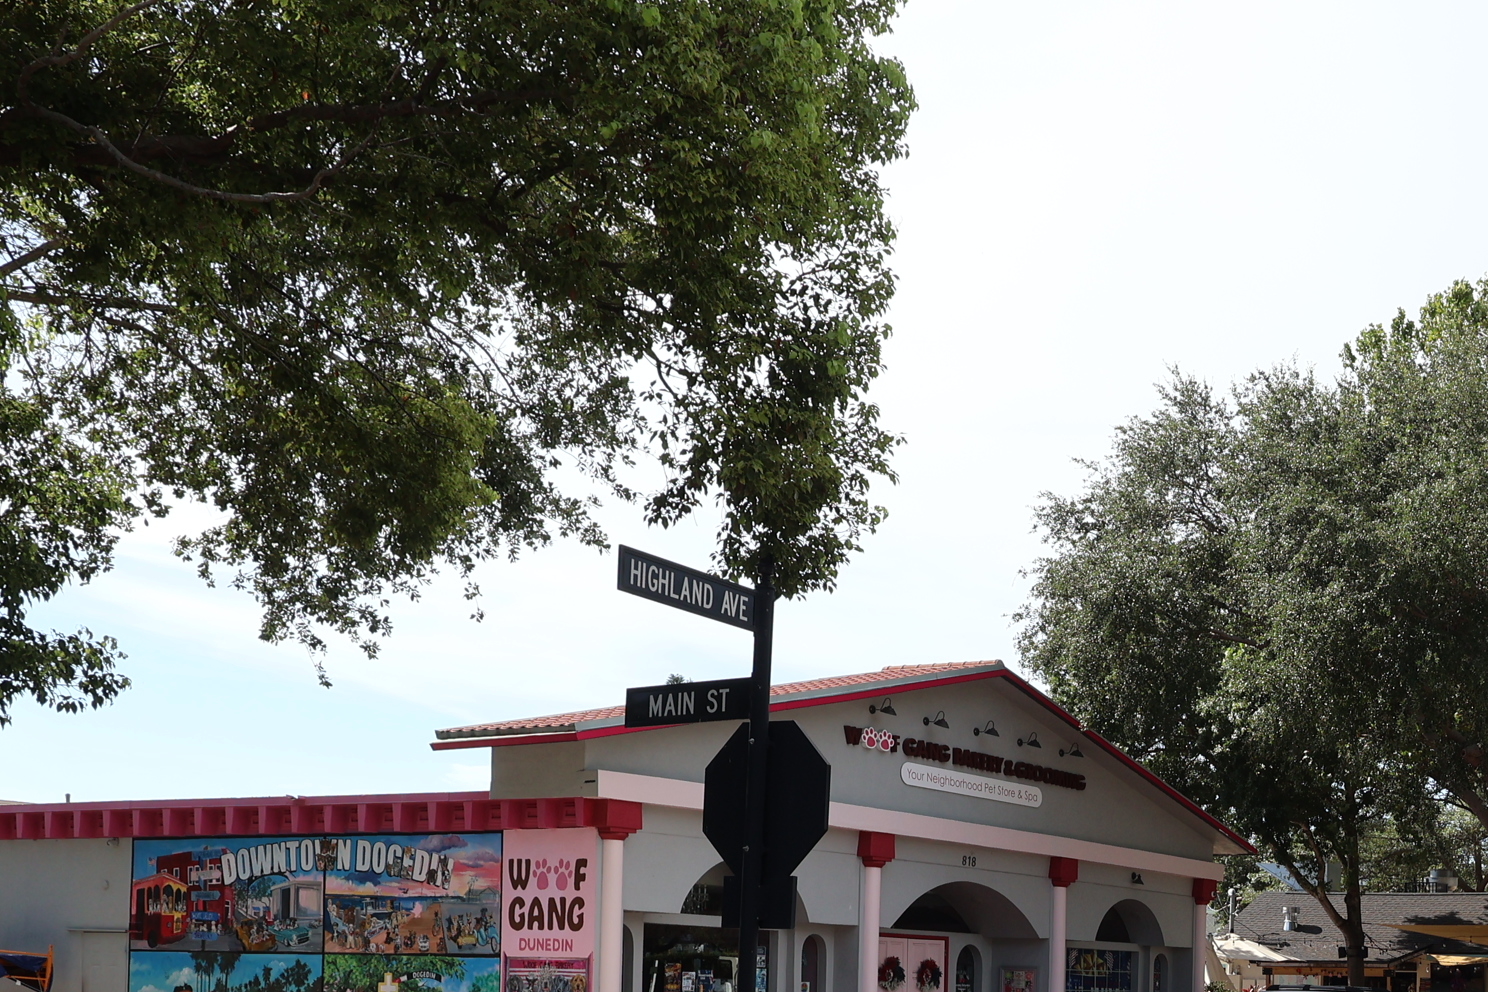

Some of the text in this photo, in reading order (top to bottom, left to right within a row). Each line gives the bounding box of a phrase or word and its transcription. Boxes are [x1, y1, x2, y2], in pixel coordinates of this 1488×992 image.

[630, 558, 748, 621] HIGHLAND AVE
[649, 688, 730, 718] MAIN ST
[902, 738, 951, 763] GANG
[953, 748, 1004, 774] BAKERY
[1014, 761, 1087, 791] GROOMING
[907, 768, 1038, 802] Your Neighborhood Pet Store & Spa
[220, 839, 351, 886] DOWNTOWN
[962, 855, 976, 867] 818
[508, 896, 585, 931] GANG
[518, 937, 573, 952] DUNEDIN
